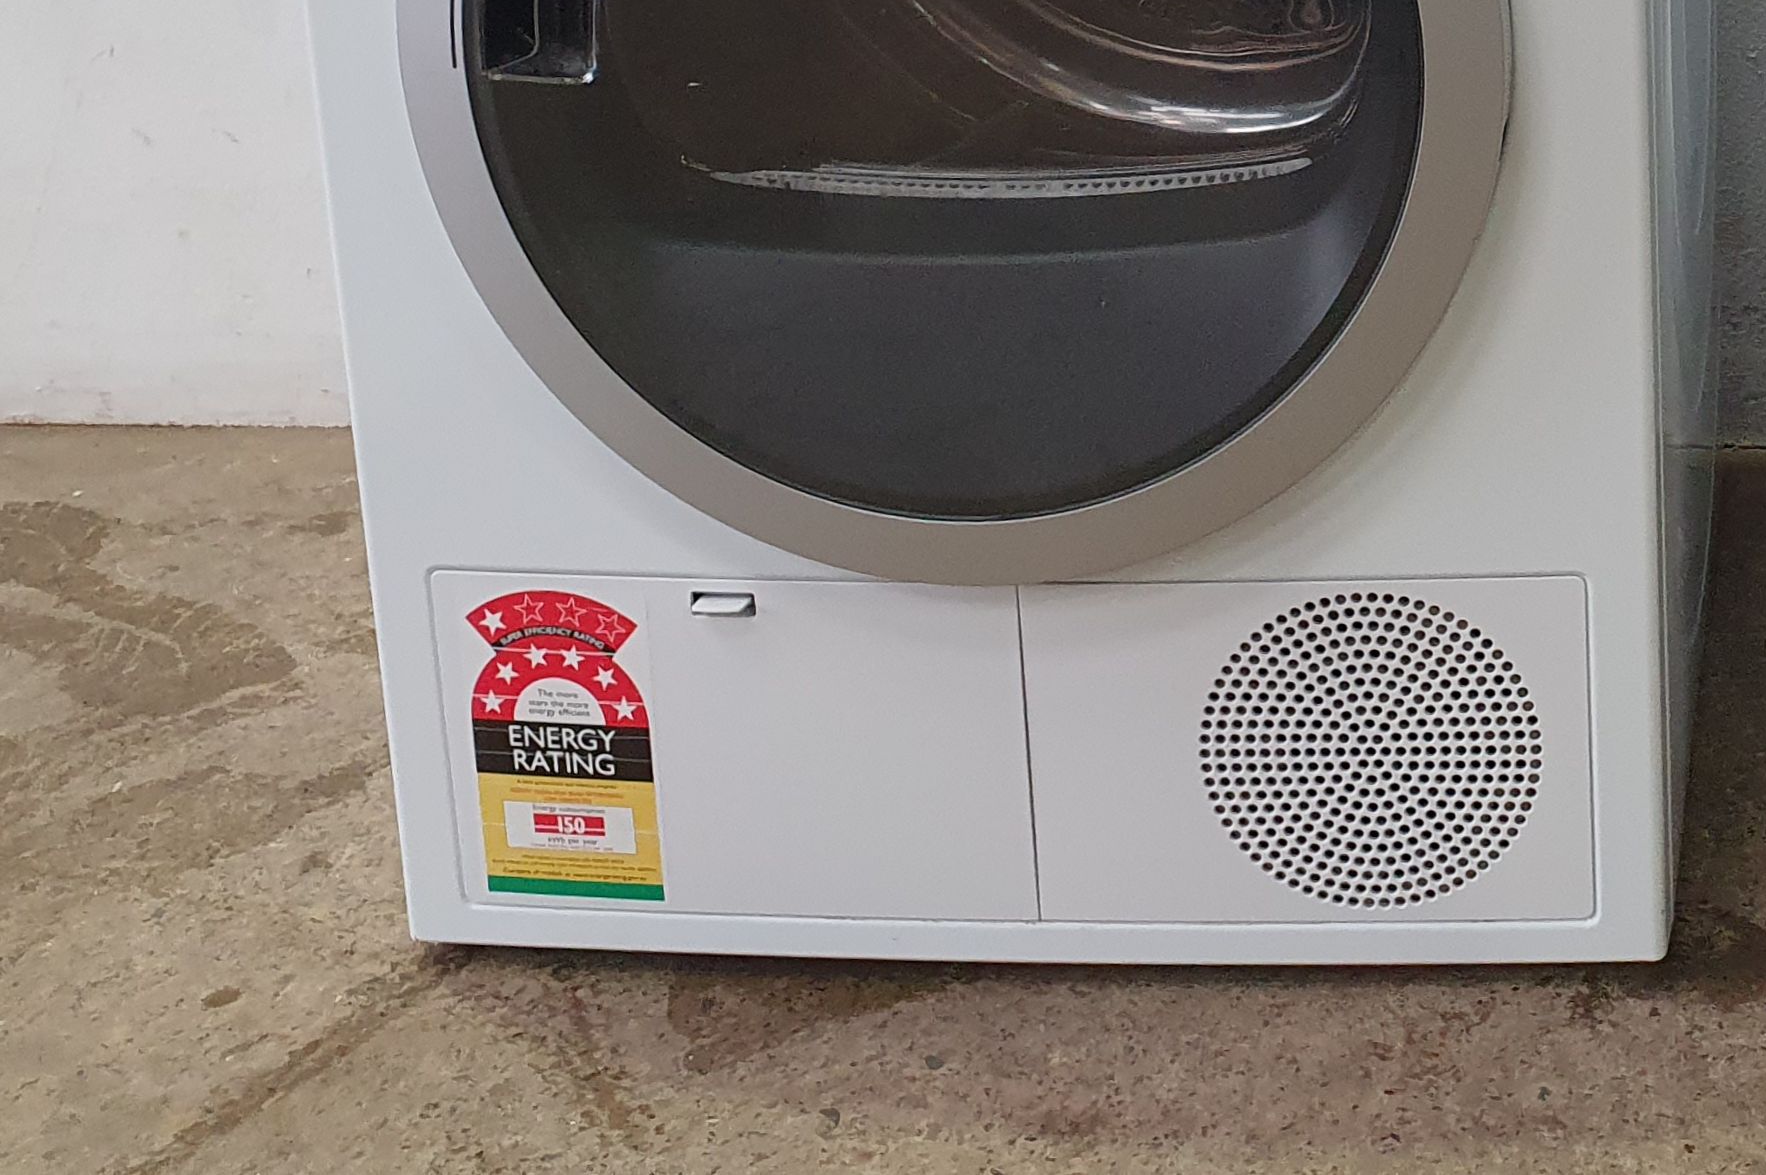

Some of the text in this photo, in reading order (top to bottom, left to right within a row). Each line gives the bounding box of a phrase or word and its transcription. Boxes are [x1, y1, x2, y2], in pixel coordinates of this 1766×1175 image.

[538, 688, 554, 698] The
[508, 724, 616, 752] ENERGY
[512, 749, 616, 775] RATING
[557, 815, 586, 834] 150
